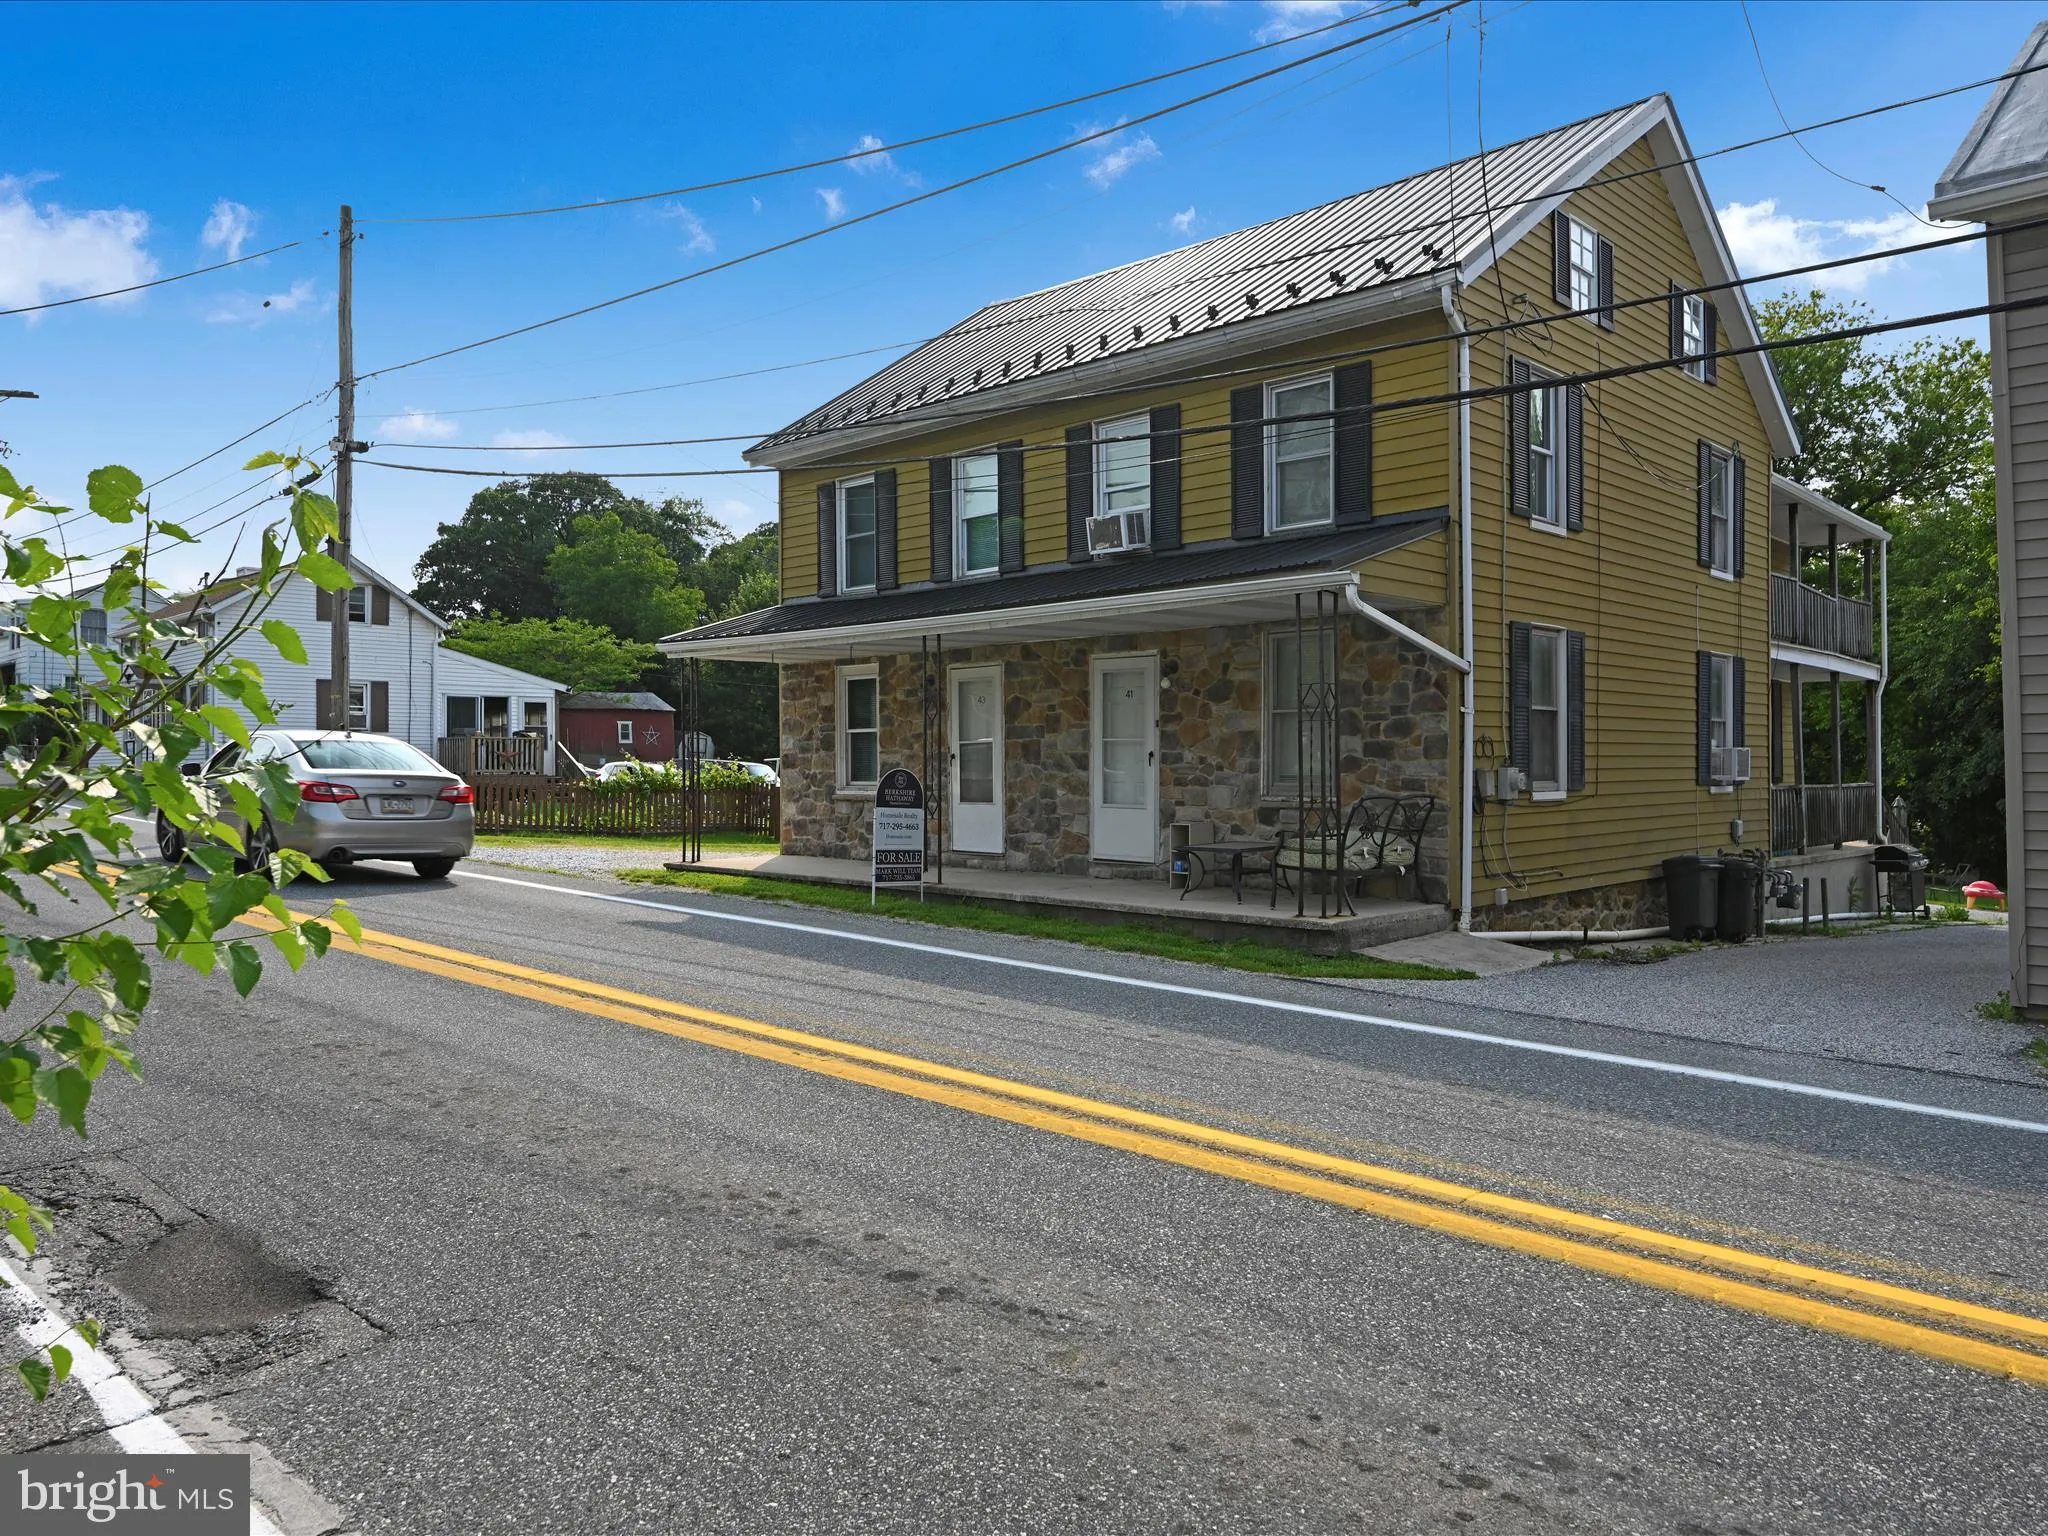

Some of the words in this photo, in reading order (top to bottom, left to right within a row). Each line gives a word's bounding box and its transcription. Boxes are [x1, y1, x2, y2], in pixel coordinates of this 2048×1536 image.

[1125, 690, 1134, 699] 41
[977, 695, 986, 704] 43
[884, 788, 916, 796] BERKSHIRE
[879, 822, 920, 831] 717-295-4663
[877, 852, 897, 863] FOR
[898, 852, 921, 863] SALE
